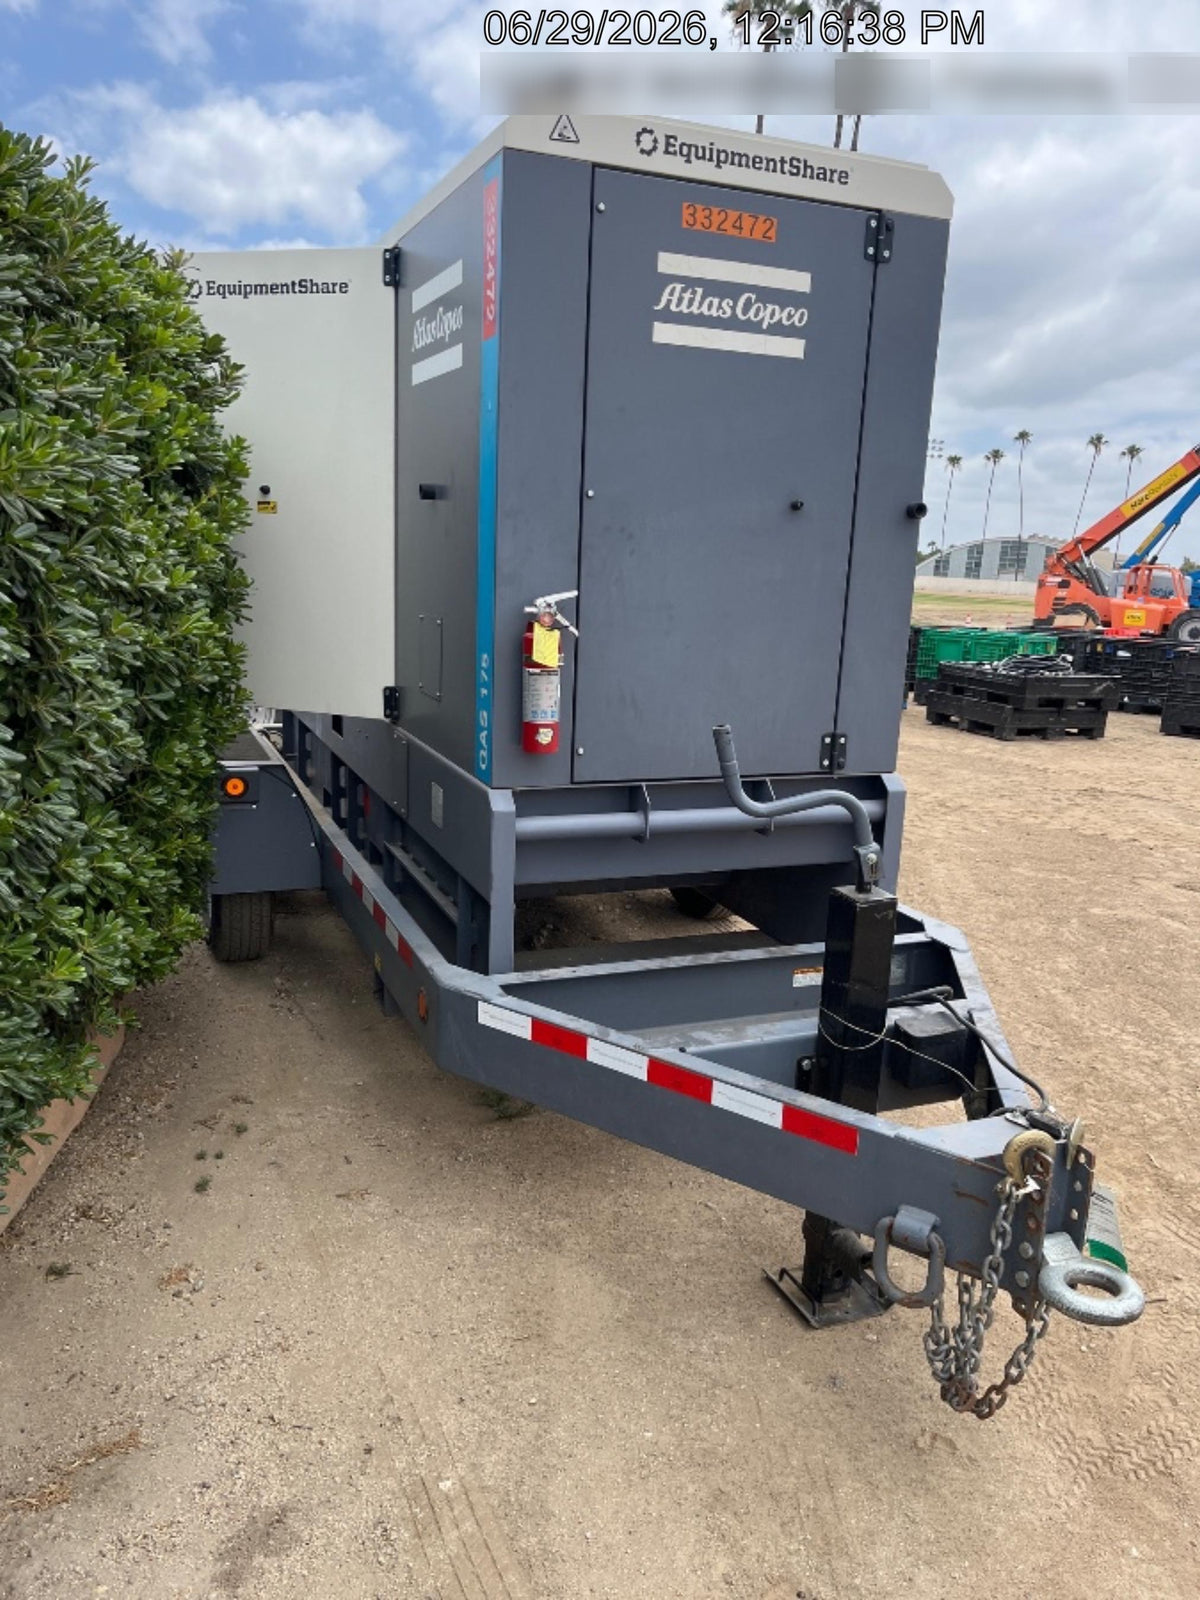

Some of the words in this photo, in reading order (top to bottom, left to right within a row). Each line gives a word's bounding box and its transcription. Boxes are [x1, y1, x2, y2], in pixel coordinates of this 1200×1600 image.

[663, 133, 849, 185] EquipmentShare
[685, 203, 775, 240] 332472
[205, 278, 349, 299] EquipmentShare
[654, 282, 733, 318] Atlas
[735, 292, 808, 329] Copco
[412, 316, 436, 352] Atlas
[436, 305, 463, 342] Copco
[480, 653, 489, 698] 175
[479, 710, 488, 770] QAS
